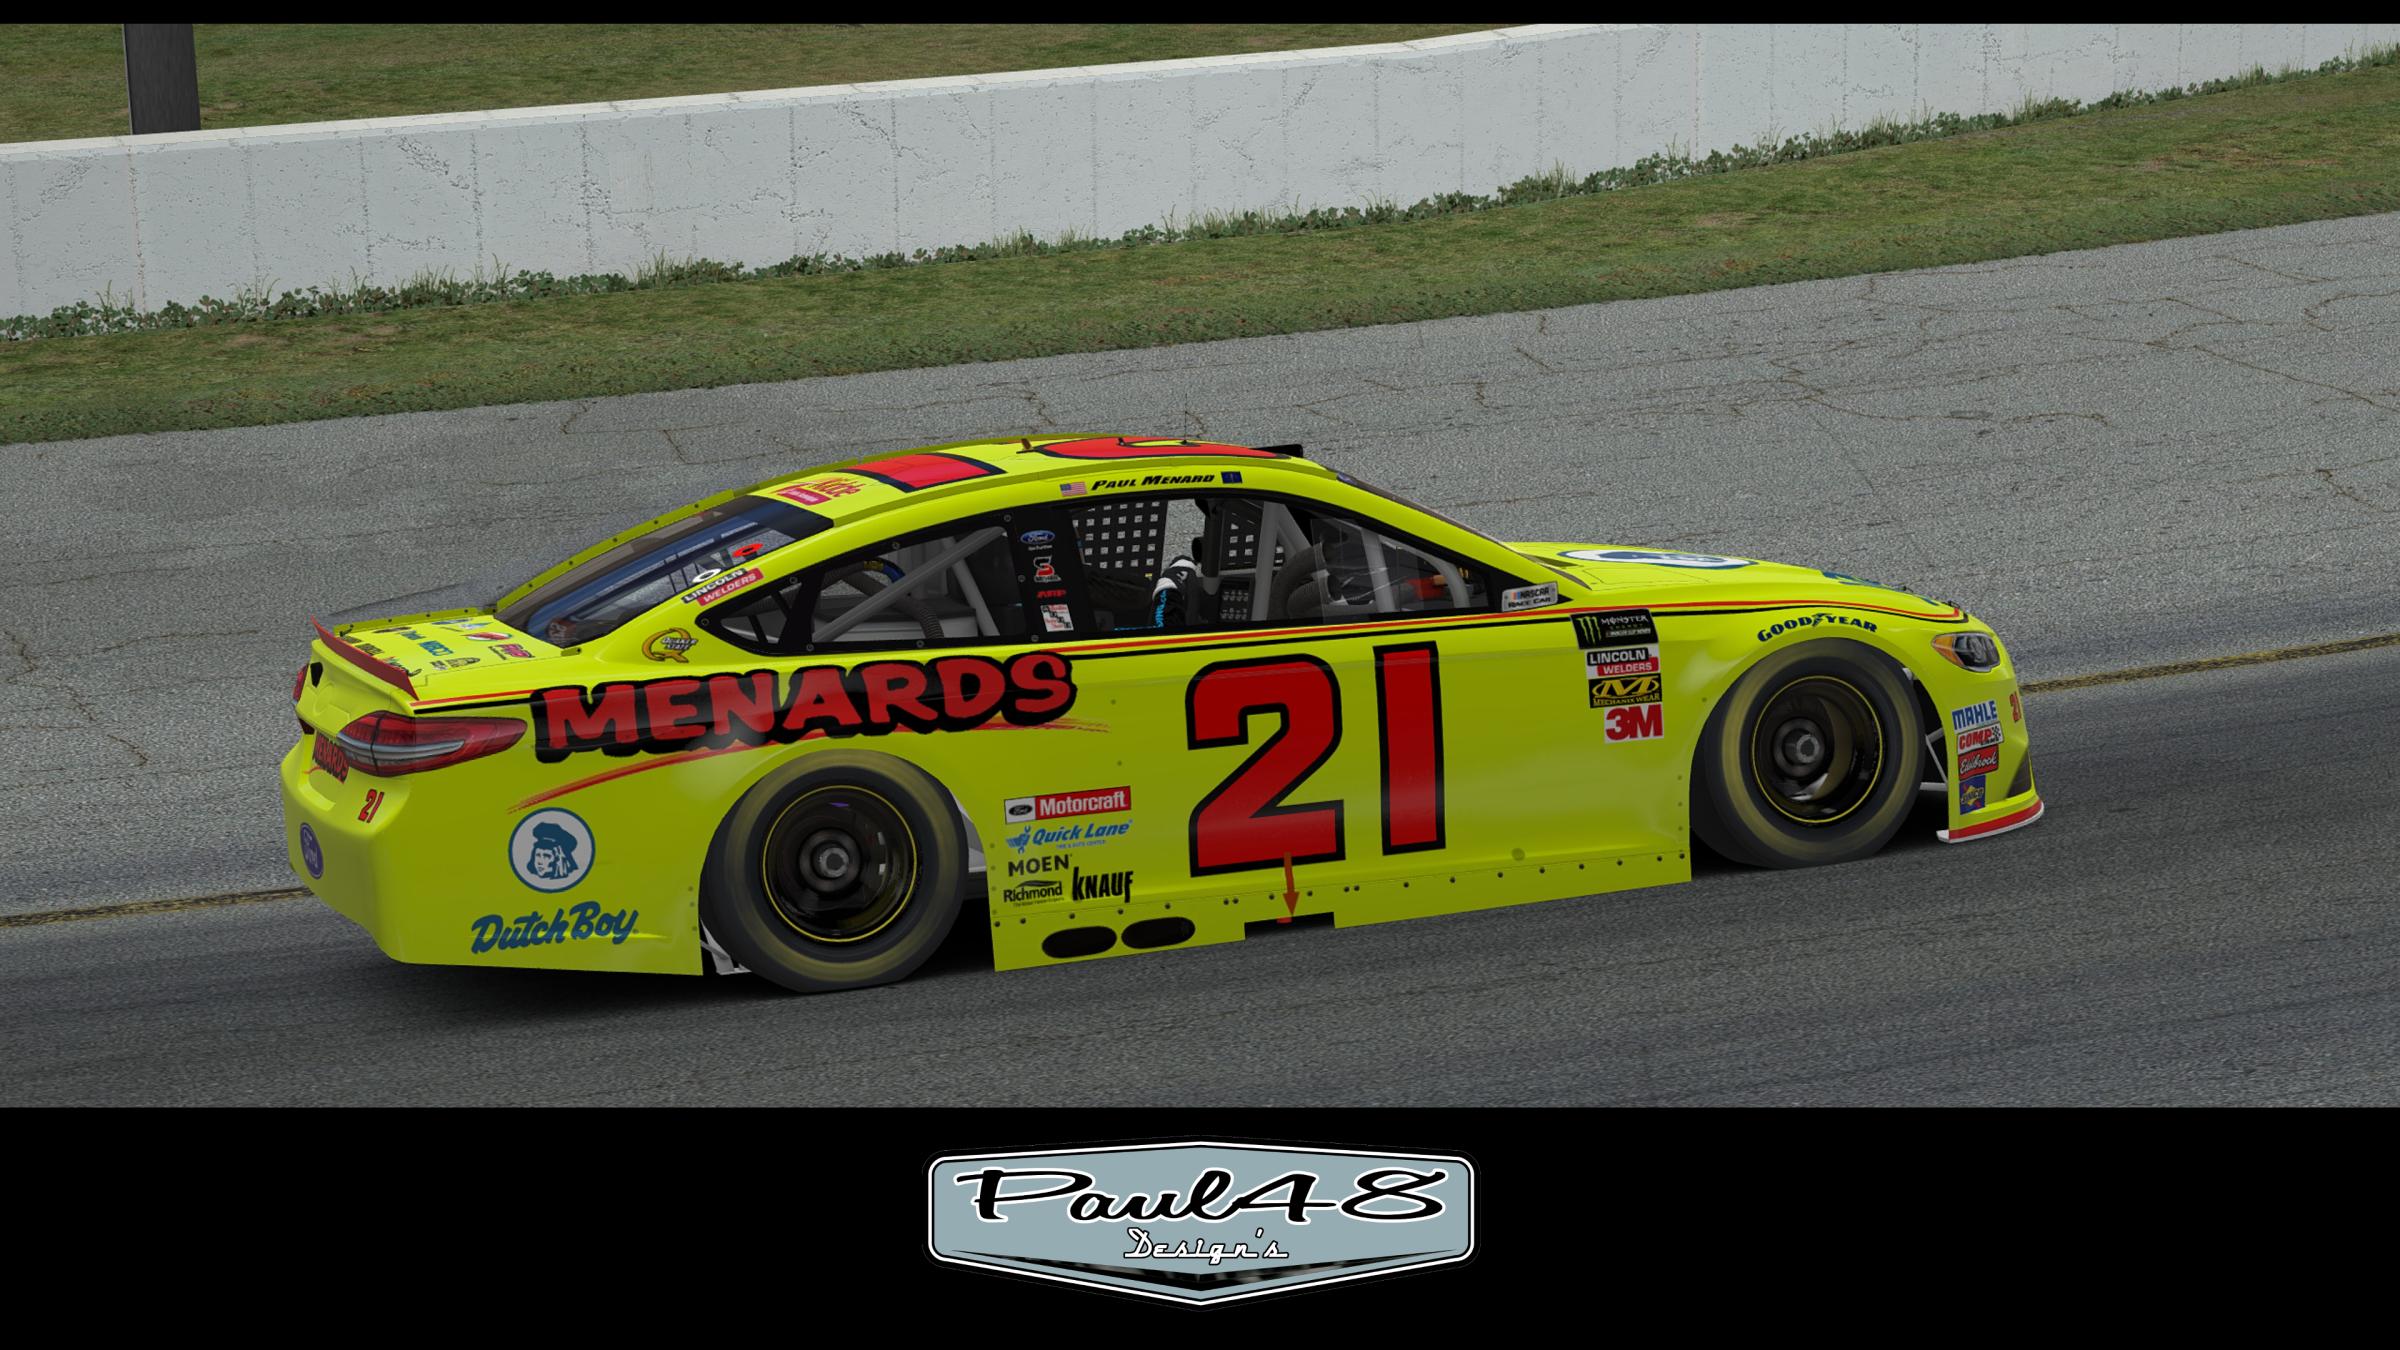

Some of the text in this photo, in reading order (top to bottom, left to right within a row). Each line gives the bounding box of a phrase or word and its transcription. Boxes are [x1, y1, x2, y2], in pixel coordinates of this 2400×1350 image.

[1091, 474, 1215, 491] PAUL MENARD
[683, 569, 745, 602] LINCOLN
[703, 573, 756, 602] WELDERS
[1521, 587, 1549, 598] NASCAR
[1589, 650, 1646, 665] LINCOLN
[1603, 662, 1653, 675] WELDERS
[530, 651, 1077, 763] MENARDS
[1952, 700, 1998, 730] MAHLE
[1606, 704, 1663, 740] 3M
[1959, 728, 1993, 749] COMP
[1185, 640, 1446, 877] 21
[357, 788, 385, 823] 21
[1040, 791, 1126, 816] Motorcraft
[1032, 823, 1130, 845] Quick Lane
[1008, 854, 1070, 876] MOEN
[1003, 880, 1063, 902] Richmond
[1072, 866, 1134, 903] KNAUF
[471, 901, 639, 954] Dutch Boy
